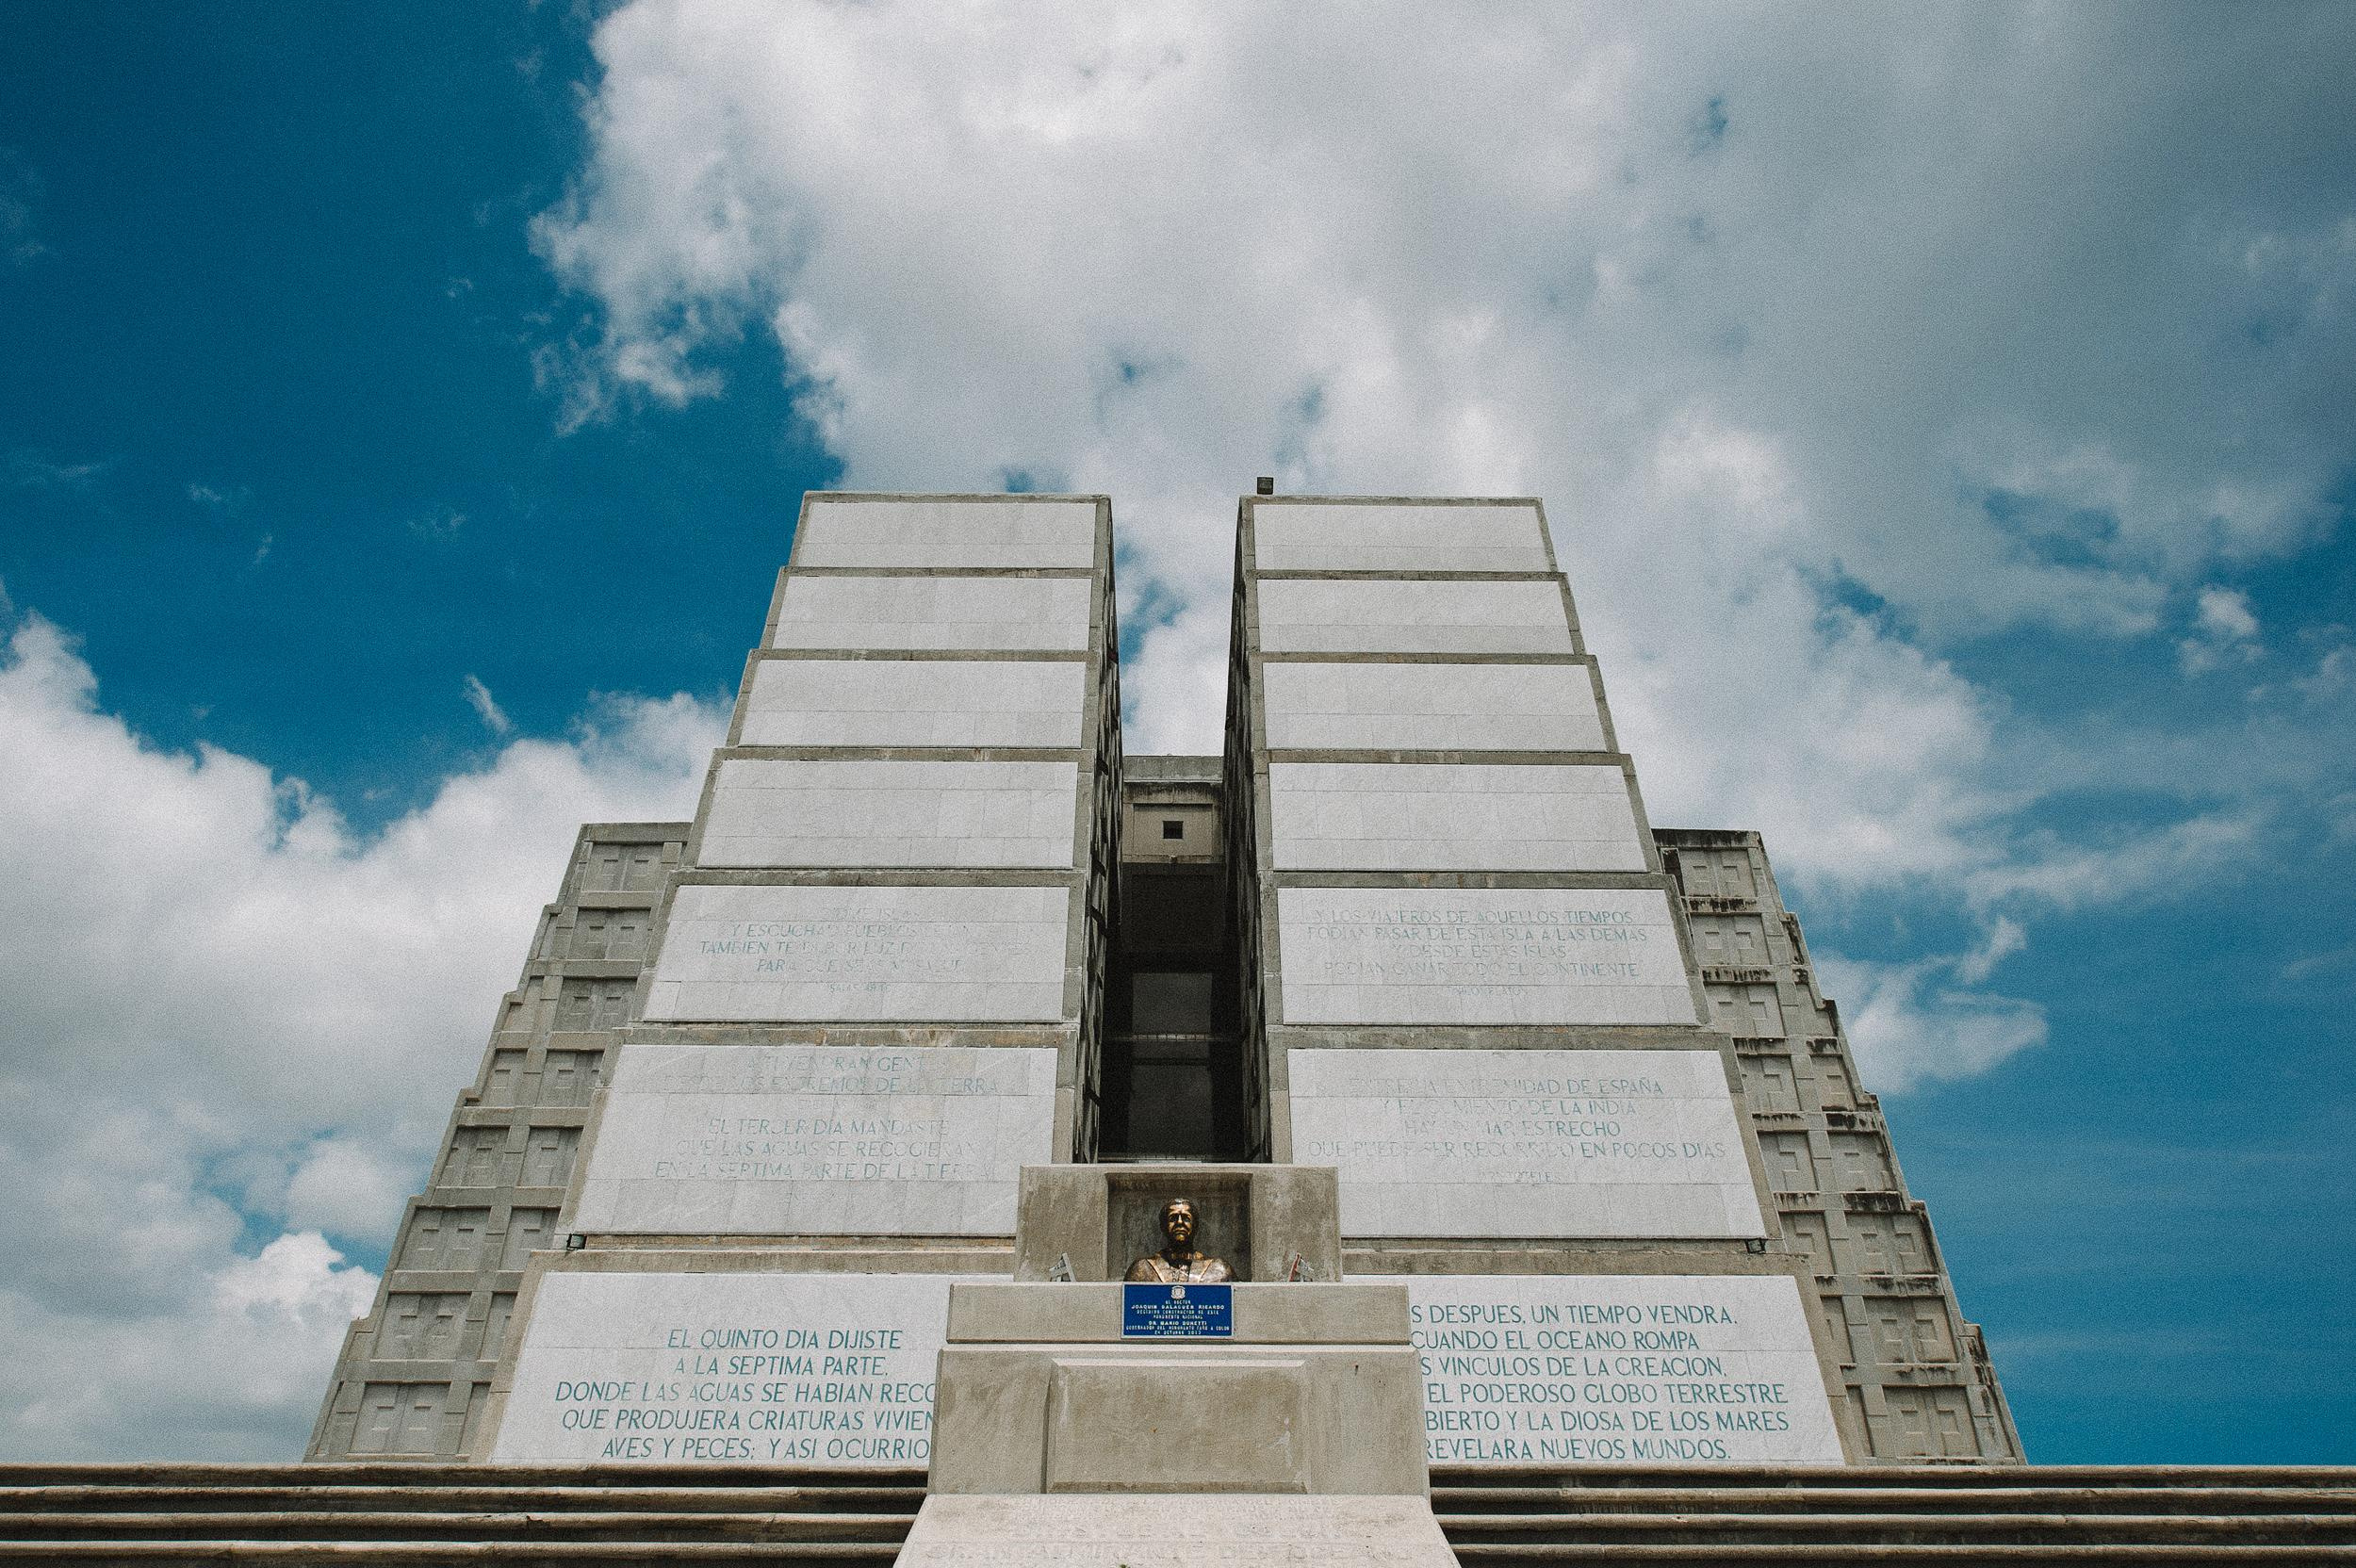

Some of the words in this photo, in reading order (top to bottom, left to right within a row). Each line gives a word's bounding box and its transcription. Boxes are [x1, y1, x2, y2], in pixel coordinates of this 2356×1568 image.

[1332, 909, 1362, 923] LOS
[1447, 910, 1469, 923] DE
[1565, 910, 1633, 924] TIEMPOS
[731, 924, 742, 938] Y
[1375, 926, 1422, 940] PASAR
[1428, 927, 1450, 941] DE
[1457, 927, 1496, 941] ESTA
[1502, 927, 1534, 941] ISLA
[1541, 928, 1551, 941] A
[1556, 928, 1585, 941] LAS
[1591, 928, 1647, 942] DEMAS
[700, 941, 769, 955] TAMBIEN
[777, 941, 796, 955] TE
[1410, 944, 1465, 958] DESDE
[1471, 945, 1518, 959] ESTAS
[1523, 945, 1567, 959] ISLAS
[1507, 962, 1528, 977] EL
[1533, 962, 1641, 977] CONTINENTE
[875, 1077, 901, 1092] DE
[1567, 1079, 1593, 1095] DE
[1599, 1076, 1663, 1095] ESPAÑA
[1529, 1100, 1554, 1115] DE
[1560, 1100, 1581, 1115] LA
[1589, 1100, 1636, 1116] INDIA
[709, 1119, 729, 1135] EL
[813, 1119, 843, 1135] DIA
[850, 1119, 949, 1135] MANDASTE
[1522, 1121, 1621, 1136] ESTRECHO
[721, 1140, 755, 1156] LAS
[826, 1141, 849, 1157] SE
[1308, 1141, 1347, 1157] QUE
[1581, 1142, 1606, 1158] EN
[1612, 1142, 1677, 1158] POCOS
[1682, 1142, 1726, 1158] DIAS
[802, 1162, 857, 1180] PARTE
[864, 1162, 891, 1180] DE
[1531, 1305, 1560, 1324] UN
[1565, 1305, 1642, 1324] TIEMPO
[667, 1329, 693, 1348] EL
[700, 1329, 778, 1349] QUINTO
[785, 1330, 819, 1349] DIA
[827, 1330, 903, 1349] DIJISTE
[1411, 1331, 1498, 1349] CUANDO
[1505, 1331, 1530, 1349] EL
[1537, 1331, 1627, 1350] OCEANO
[1634, 1331, 1700, 1350] ROMPA
[674, 1356, 685, 1375] A
[694, 1356, 719, 1375] LA
[727, 1356, 813, 1376] SEPTIMA
[1438, 1357, 1540, 1376] VINCULOS
[1547, 1357, 1576, 1376] DE
[1583, 1357, 1611, 1376] LA
[555, 1381, 636, 1402] DONDE
[641, 1382, 679, 1403] LAS
[688, 1382, 754, 1403] AGUAS
[761, 1382, 788, 1403] SE
[794, 1382, 874, 1403] HABIAN
[1428, 1383, 1453, 1402] EL
[1461, 1383, 1576, 1403] PODEROSO
[1583, 1383, 1658, 1403] GLOBO
[1664, 1383, 1789, 1404] TERRESTRE
[562, 1409, 610, 1430] QUE
[615, 1410, 741, 1430] PRODUJERA
[748, 1410, 864, 1430] CRIATURAS
[1425, 1411, 1500, 1430] BIERTO
[1507, 1411, 1517, 1430] Y
[1528, 1411, 1553, 1430] LA
[1561, 1411, 1625, 1431] DIOSA
[1632, 1412, 1663, 1431] DE
[1670, 1412, 1710, 1431] LOS
[1715, 1412, 1790, 1431] MARES
[601, 1438, 653, 1459] AVES
[663, 1438, 675, 1459] Y
[769, 1439, 781, 1459] Y
[784, 1439, 817, 1459] ASI
[826, 1438, 930, 1460] OCURRIO
[1541, 1439, 1626, 1460] NUEVOS
[1632, 1439, 1731, 1460] MUNDOS.
